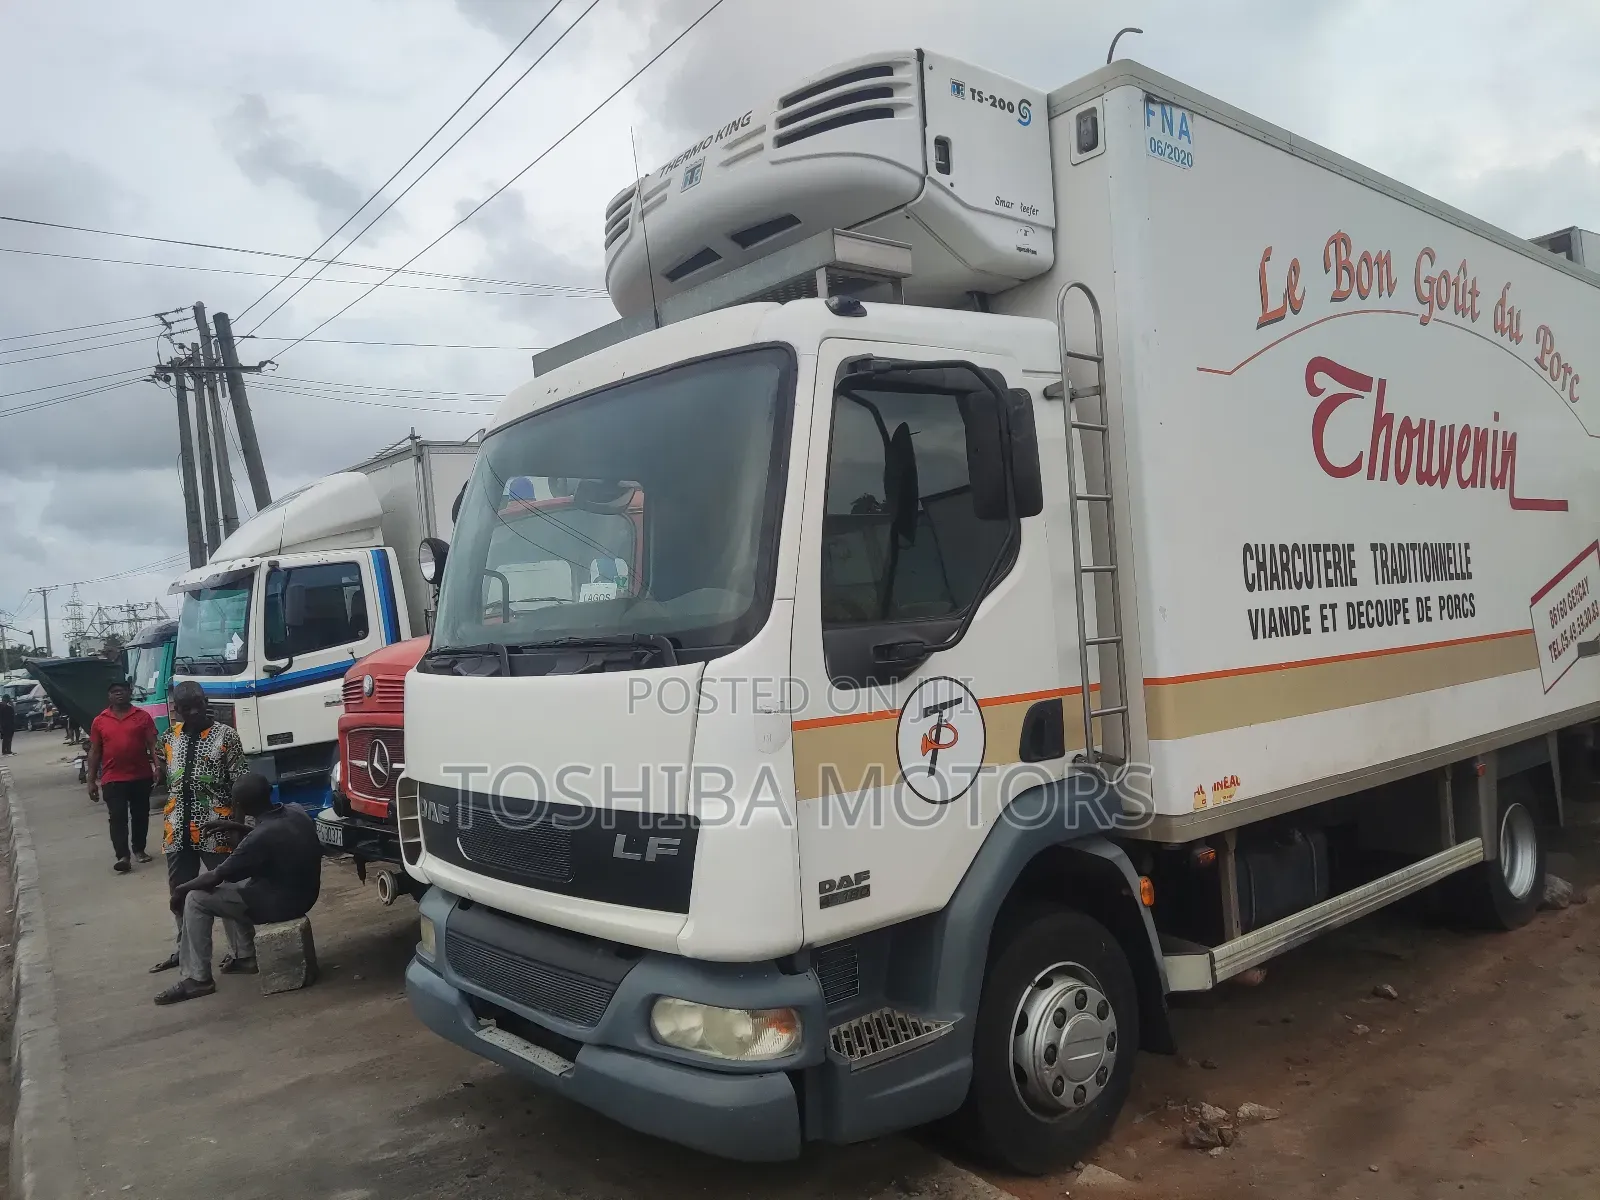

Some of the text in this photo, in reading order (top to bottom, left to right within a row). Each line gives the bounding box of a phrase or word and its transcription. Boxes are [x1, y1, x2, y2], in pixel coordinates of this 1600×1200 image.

[969, 87, 1015, 114] TS-200
[1145, 100, 1191, 144] FNA
[660, 134, 714, 178] THERMO
[714, 109, 753, 143] KING
[1149, 136, 1193, 168] 06/2020
[1255, 229, 1580, 403] Le Bon Goût du Porc
[1304, 355, 1569, 512] Thouvenin
[1242, 541, 1473, 593] CHARCUTERIE TRADITIONNELLE
[1247, 592, 1476, 641] VIANDE ET DECOUPE DE PORCS
[420, 797, 450, 825] DAF
[612, 833, 682, 862] LF
[818, 869, 871, 895] DAF
